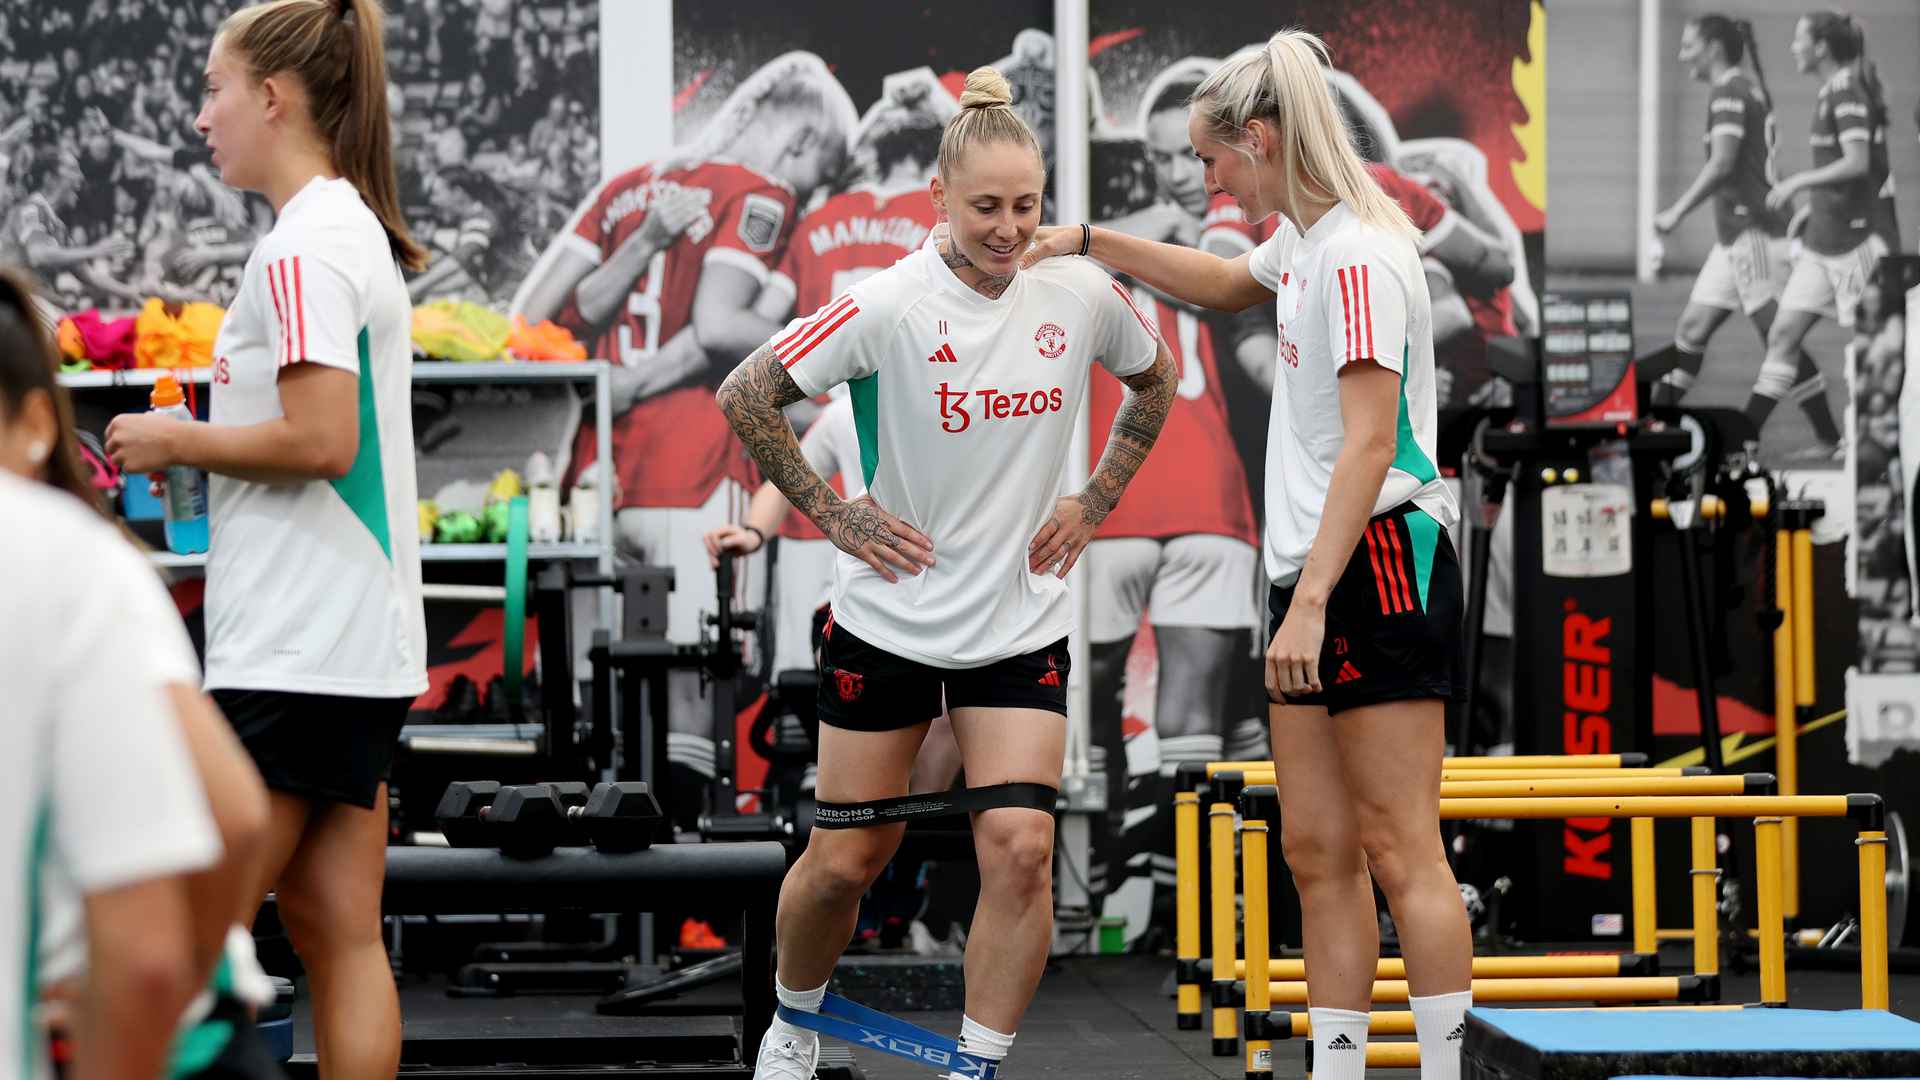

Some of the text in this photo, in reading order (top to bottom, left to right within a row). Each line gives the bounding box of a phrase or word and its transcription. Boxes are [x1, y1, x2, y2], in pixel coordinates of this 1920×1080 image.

[975, 387, 1062, 420] Tezos
[1563, 612, 1612, 880] KSER
[859, 1028, 951, 1066] BOX
